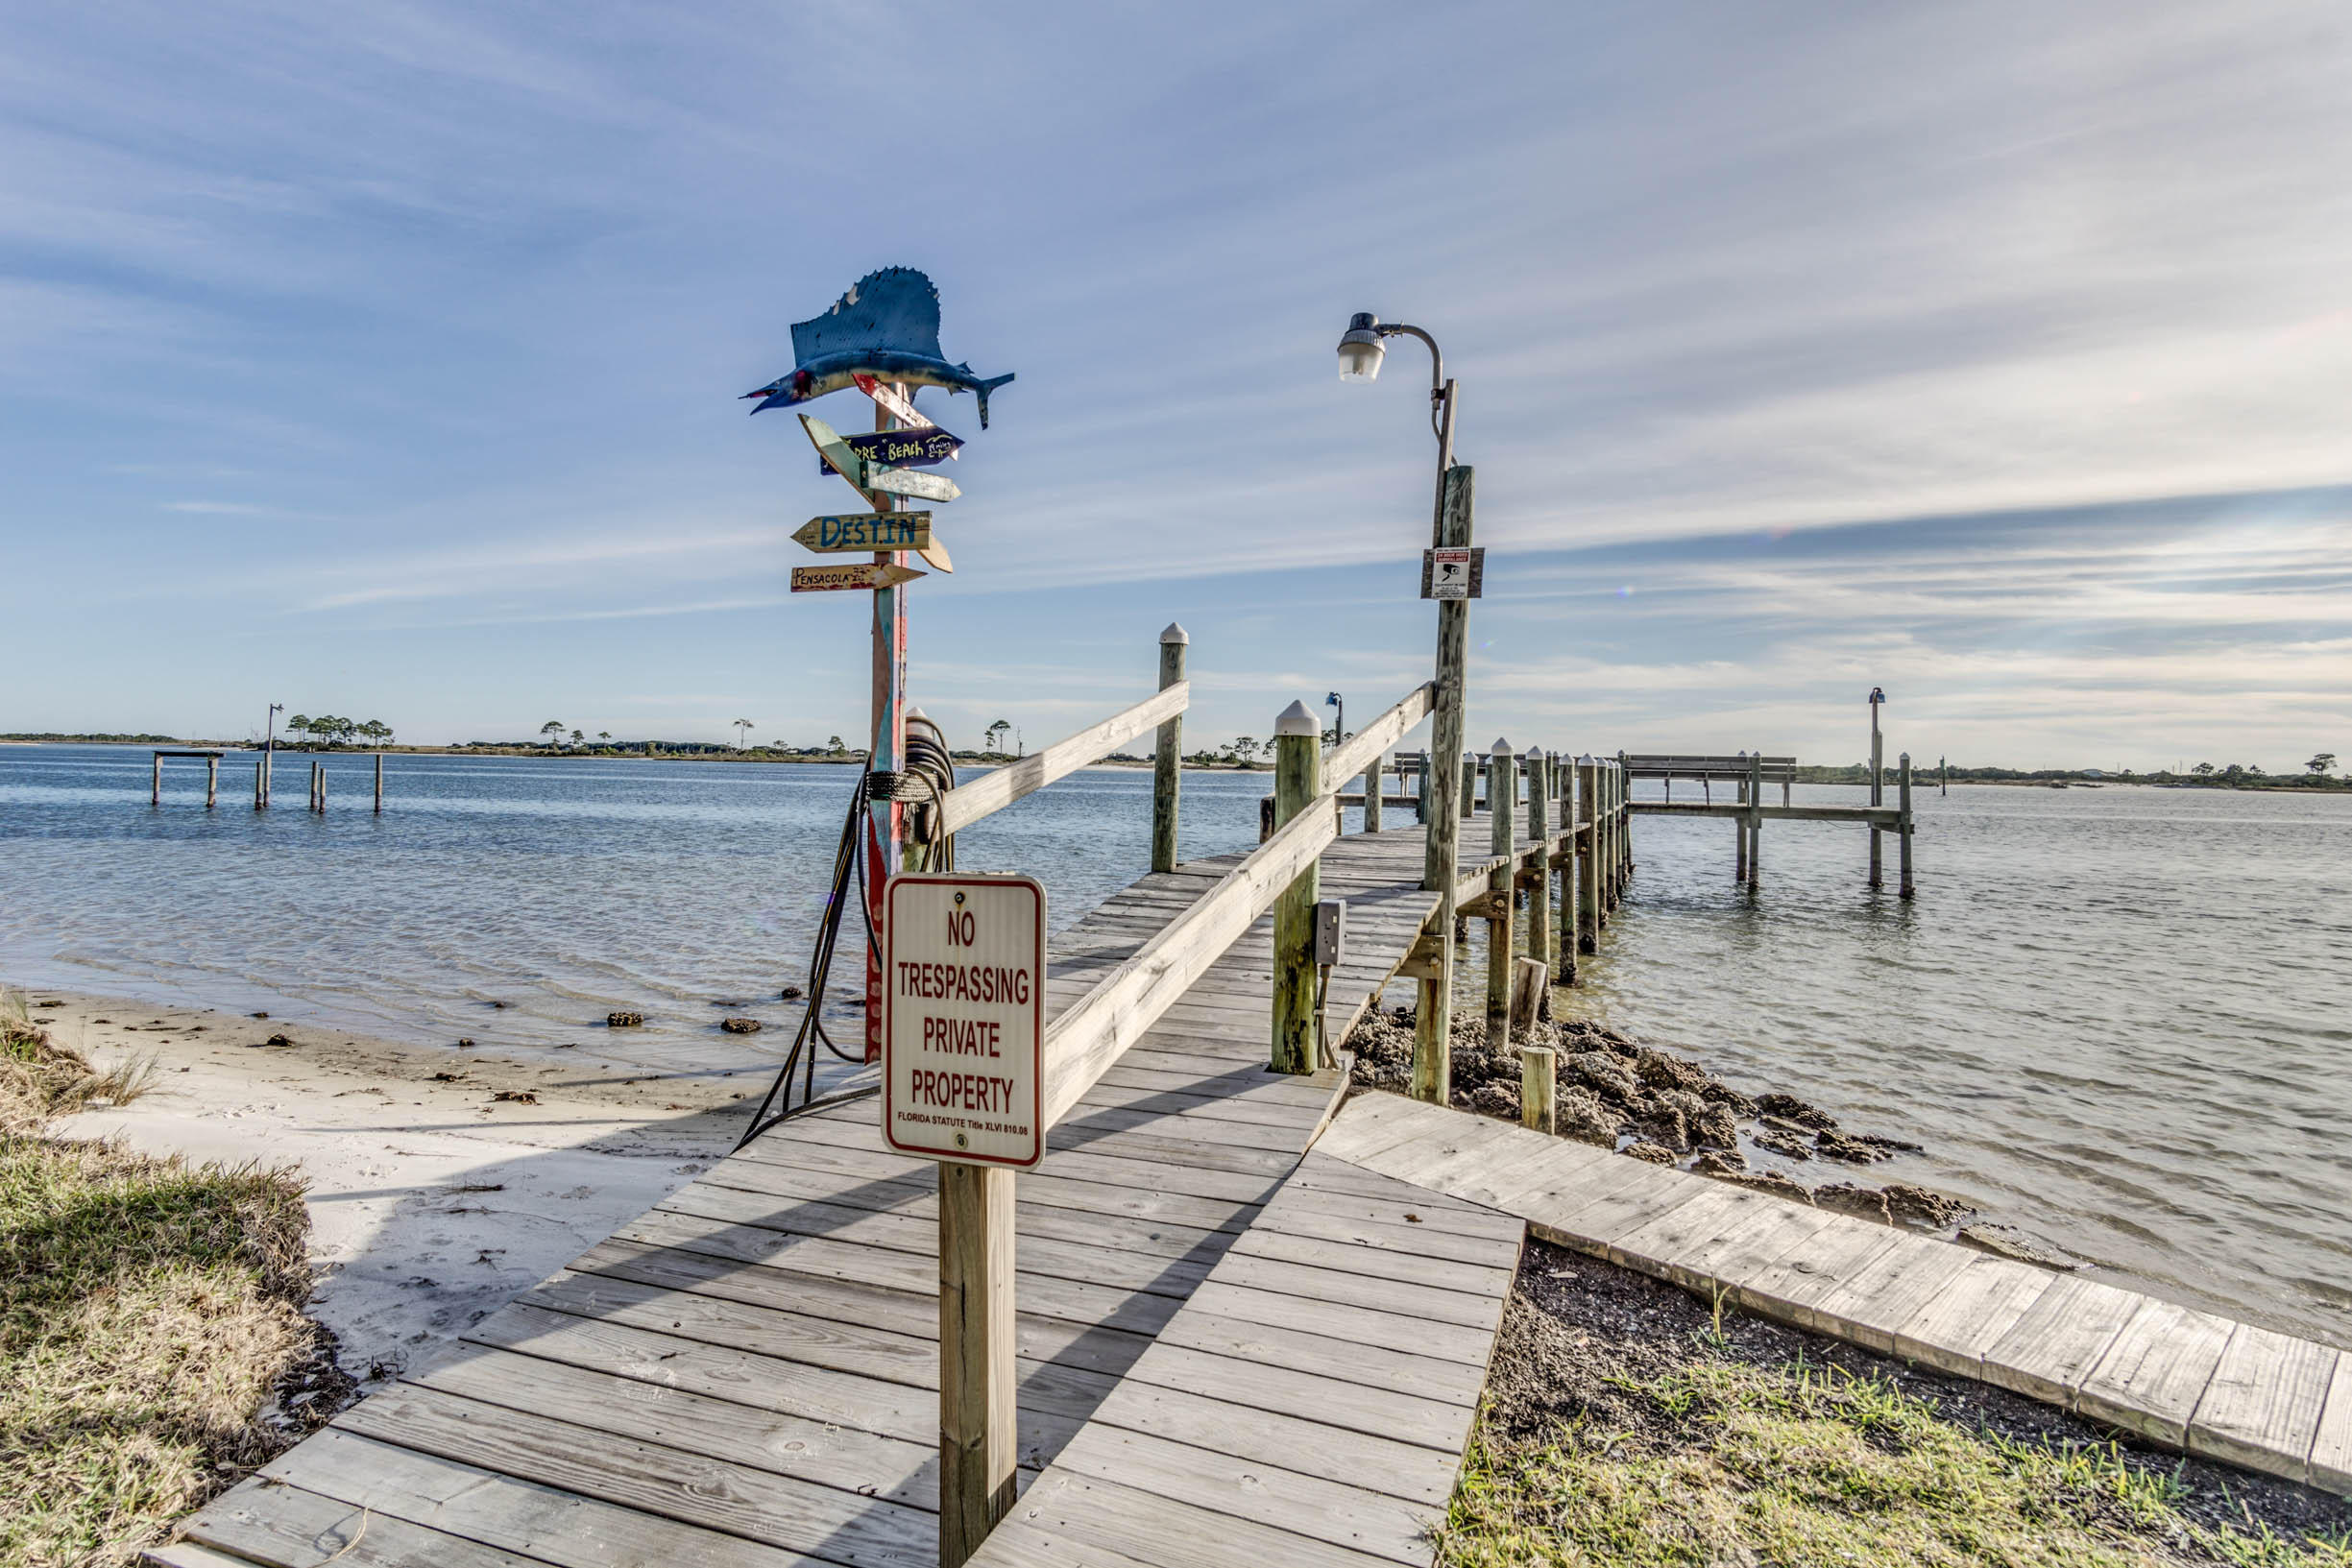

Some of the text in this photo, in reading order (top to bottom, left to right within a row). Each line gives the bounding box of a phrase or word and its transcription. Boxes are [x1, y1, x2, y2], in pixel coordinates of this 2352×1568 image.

[820, 517, 916, 547] DESTIN
[795, 567, 849, 585] PENSACOLA
[948, 910, 975, 947] NO
[898, 962, 1029, 1005] TRESPASSING
[924, 1017, 1001, 1058] PRIVATE
[911, 1070, 1014, 1115] PROPERTY
[898, 1111, 1029, 1136] FLORIDA STATUTE Title XLVI 810.08
